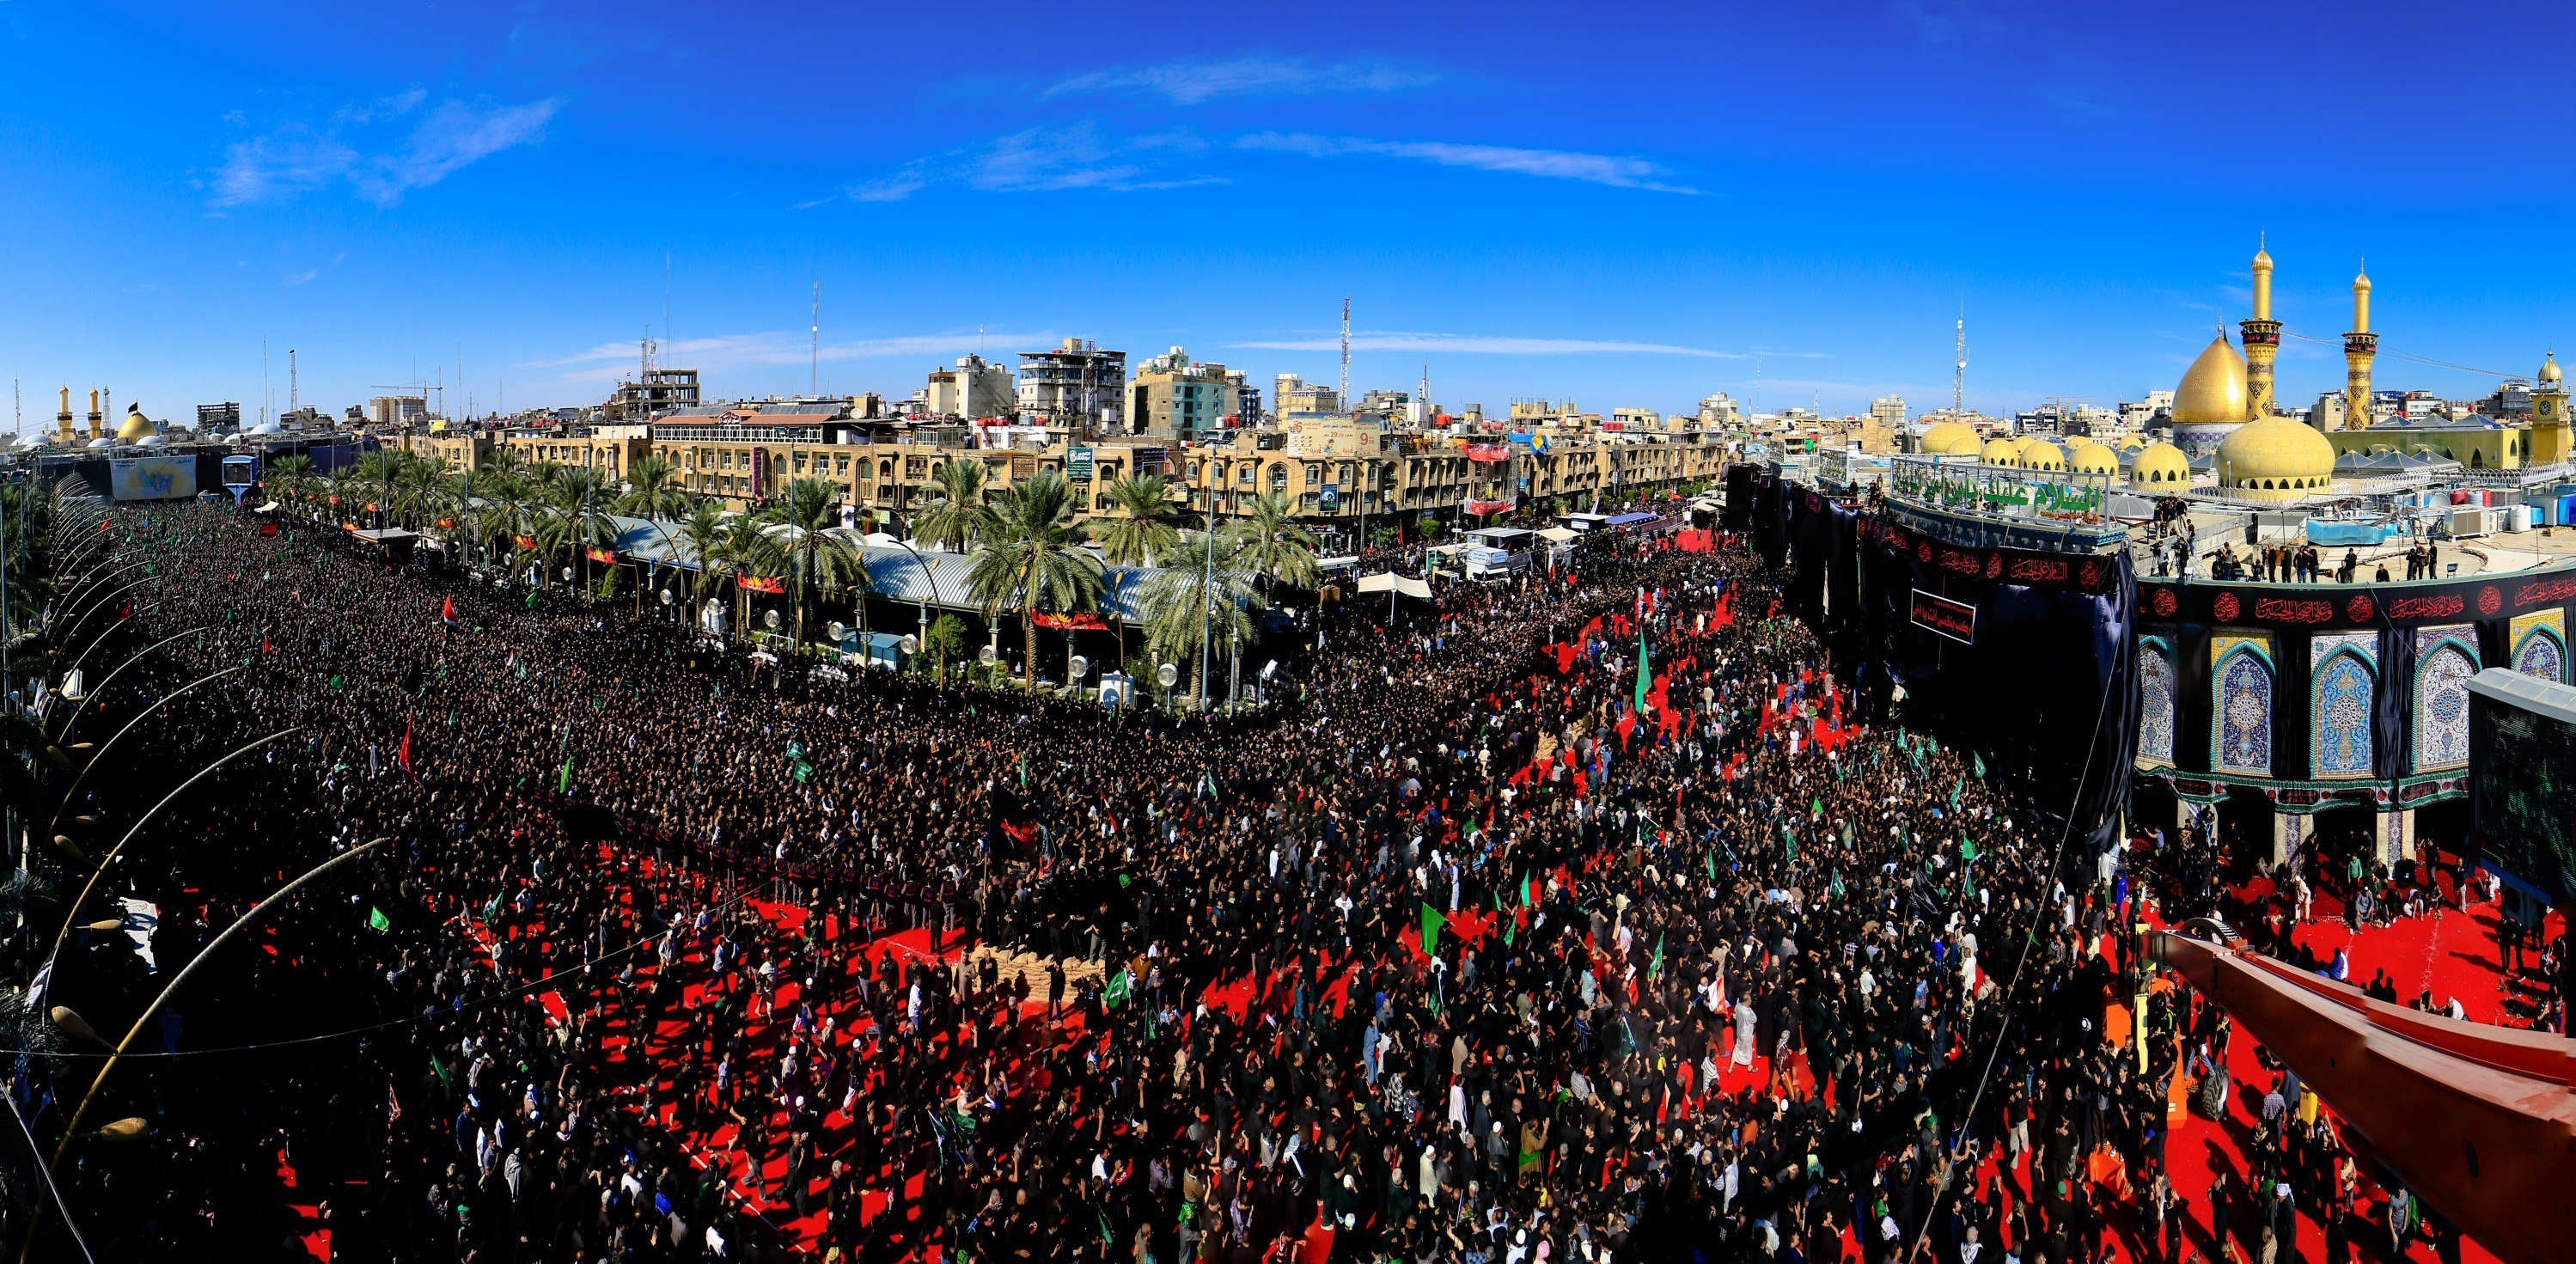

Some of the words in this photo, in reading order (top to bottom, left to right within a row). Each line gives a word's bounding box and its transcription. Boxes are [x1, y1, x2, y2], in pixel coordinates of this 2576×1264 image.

[1360, 432, 1369, 445] 9
[1984, 479, 2029, 510] عليك
[2034, 481, 2101, 516] السلام
[2514, 582, 2545, 607] الحسين
[2256, 598, 2294, 619] الحسين
[2390, 597, 2426, 619] الحسين
